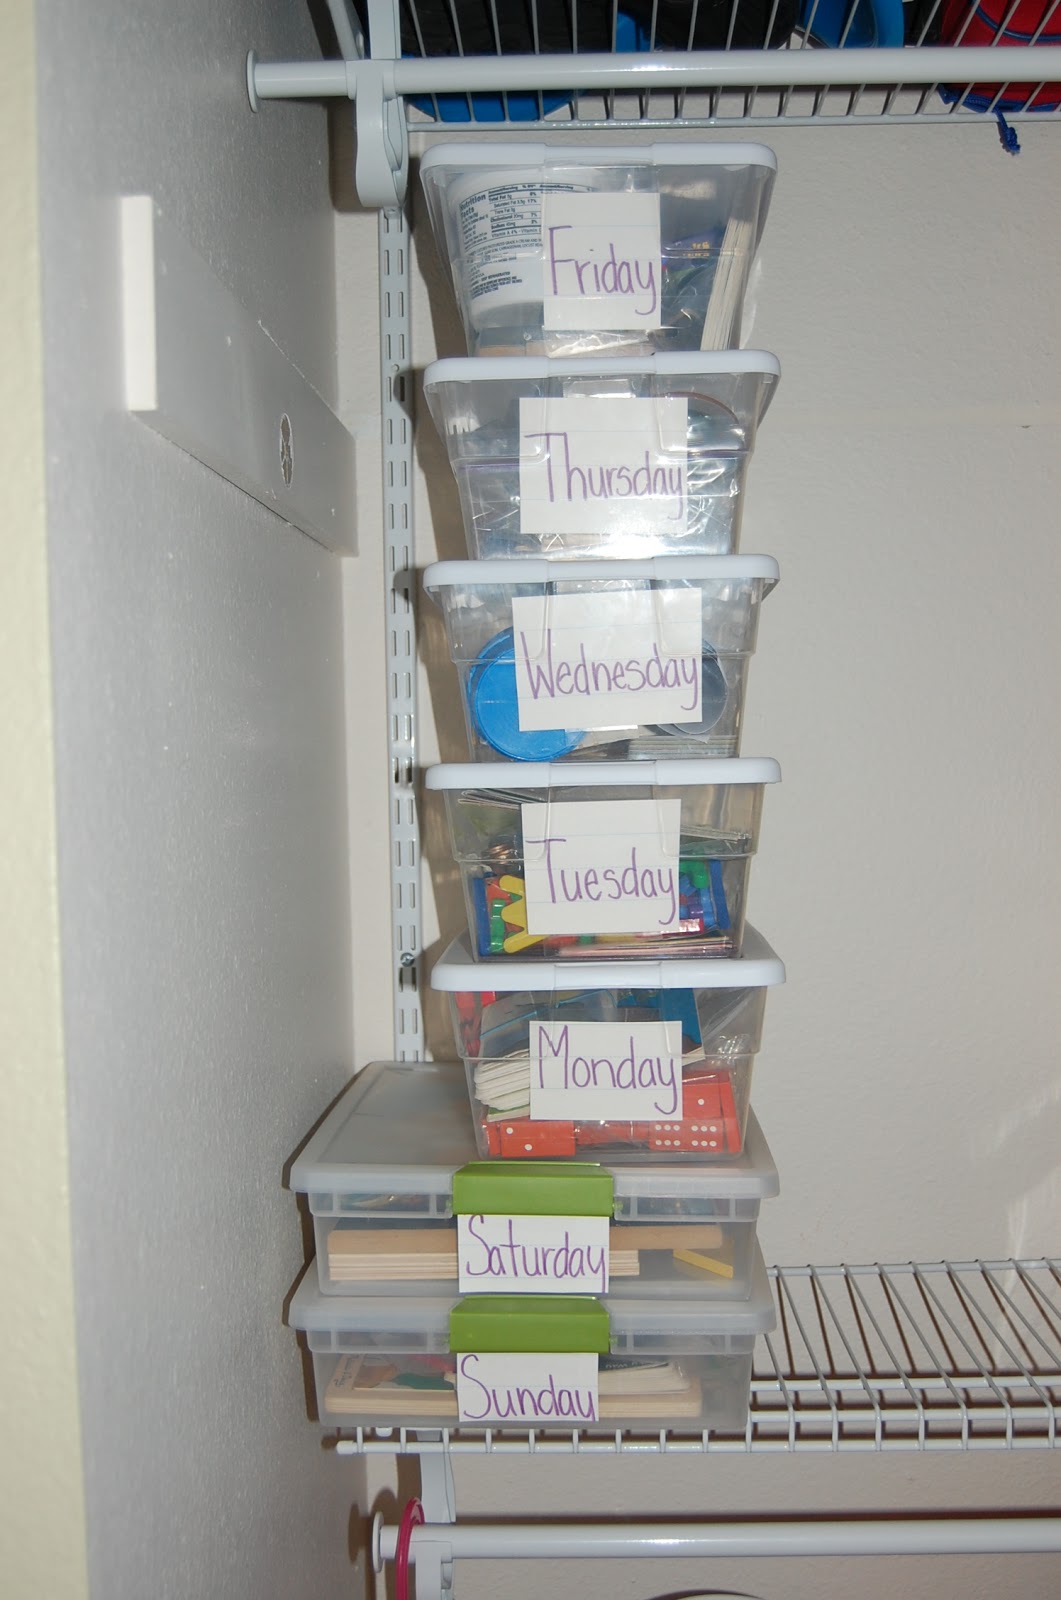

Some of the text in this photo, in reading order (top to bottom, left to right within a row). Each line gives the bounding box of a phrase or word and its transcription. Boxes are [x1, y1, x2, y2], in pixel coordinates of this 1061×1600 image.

[459, 194, 486, 210] Nutrition
[548, 225, 657, 316] Friday
[524, 432, 684, 520] Thursday
[520, 628, 698, 711] Wednesday
[524, 838, 678, 925] Tuesday
[538, 1024, 678, 1115] Monday
[466, 1214, 606, 1294] Saturday
[460, 1354, 596, 1422] Sunday
